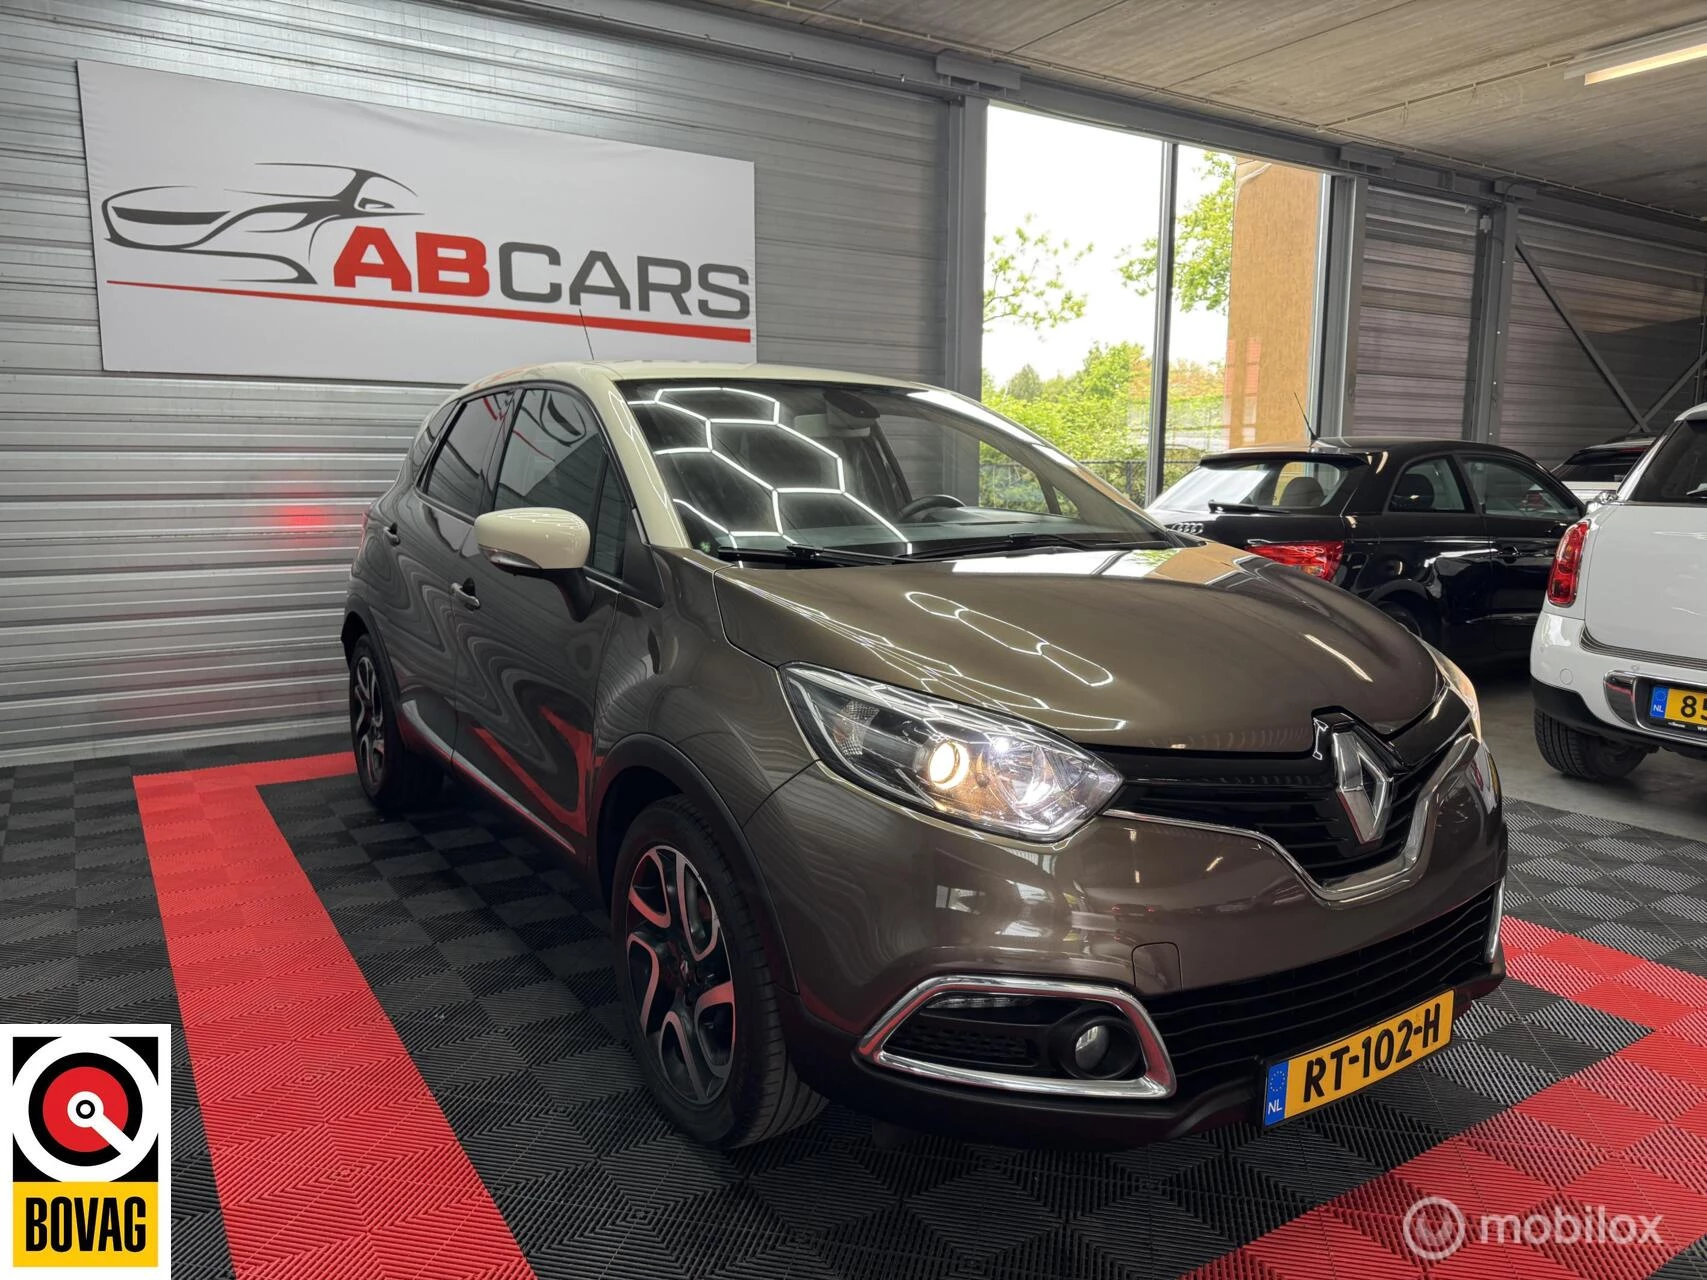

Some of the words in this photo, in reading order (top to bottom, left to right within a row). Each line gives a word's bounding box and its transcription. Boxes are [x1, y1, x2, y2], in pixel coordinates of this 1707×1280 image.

[1653, 704, 1664, 713] NL
[1268, 1098, 1283, 1115] NL
[1302, 1002, 1441, 1103] RT-102-H
